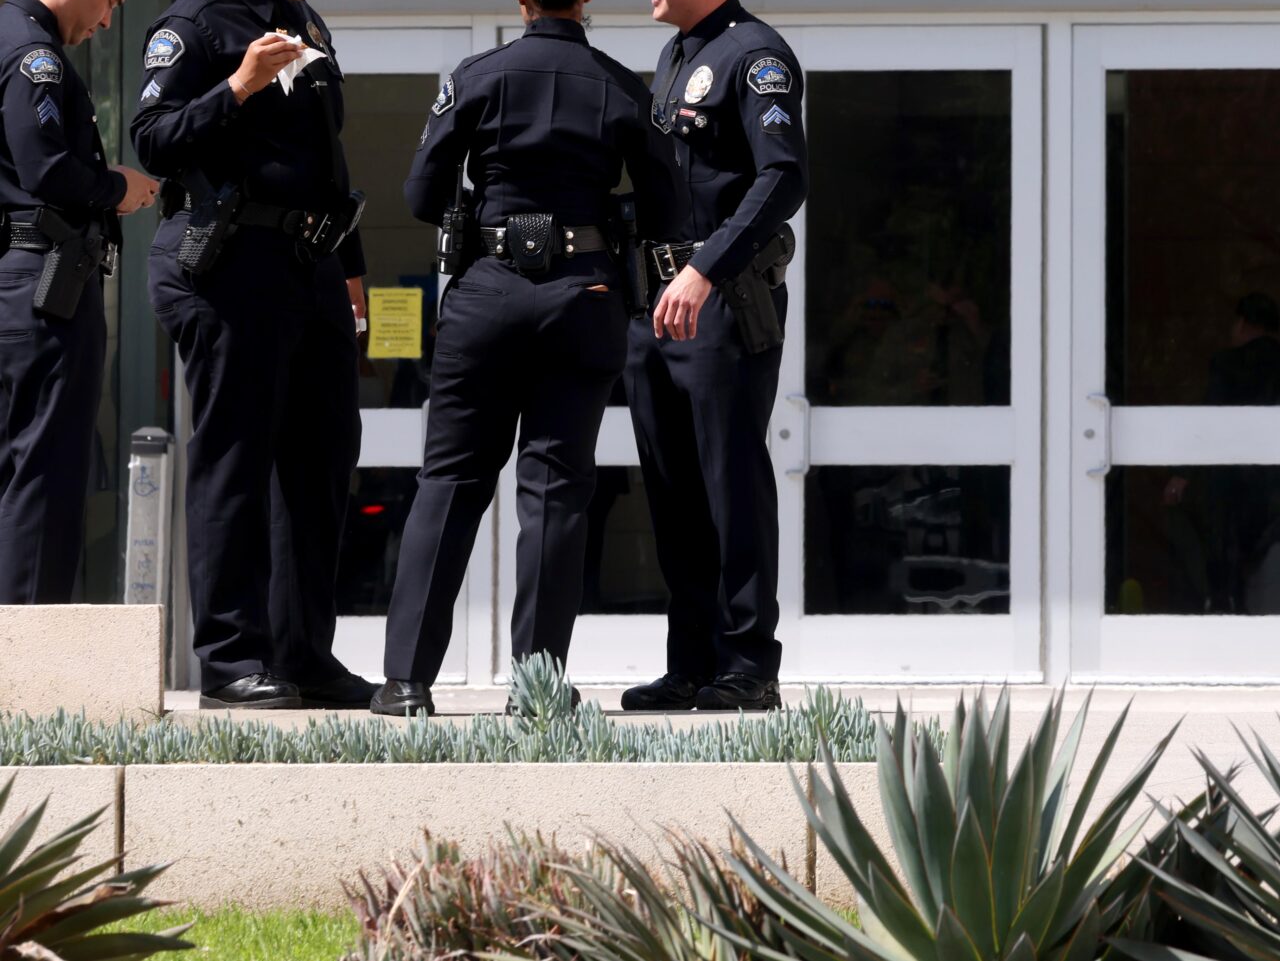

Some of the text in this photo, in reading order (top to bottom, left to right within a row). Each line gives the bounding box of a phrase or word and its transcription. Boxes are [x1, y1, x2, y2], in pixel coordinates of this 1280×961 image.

[24, 50, 60, 65] BURBANK
[751, 59, 787, 75] BURBANK
[33, 73, 60, 81] POLICE
[760, 83, 787, 91] POLICE
